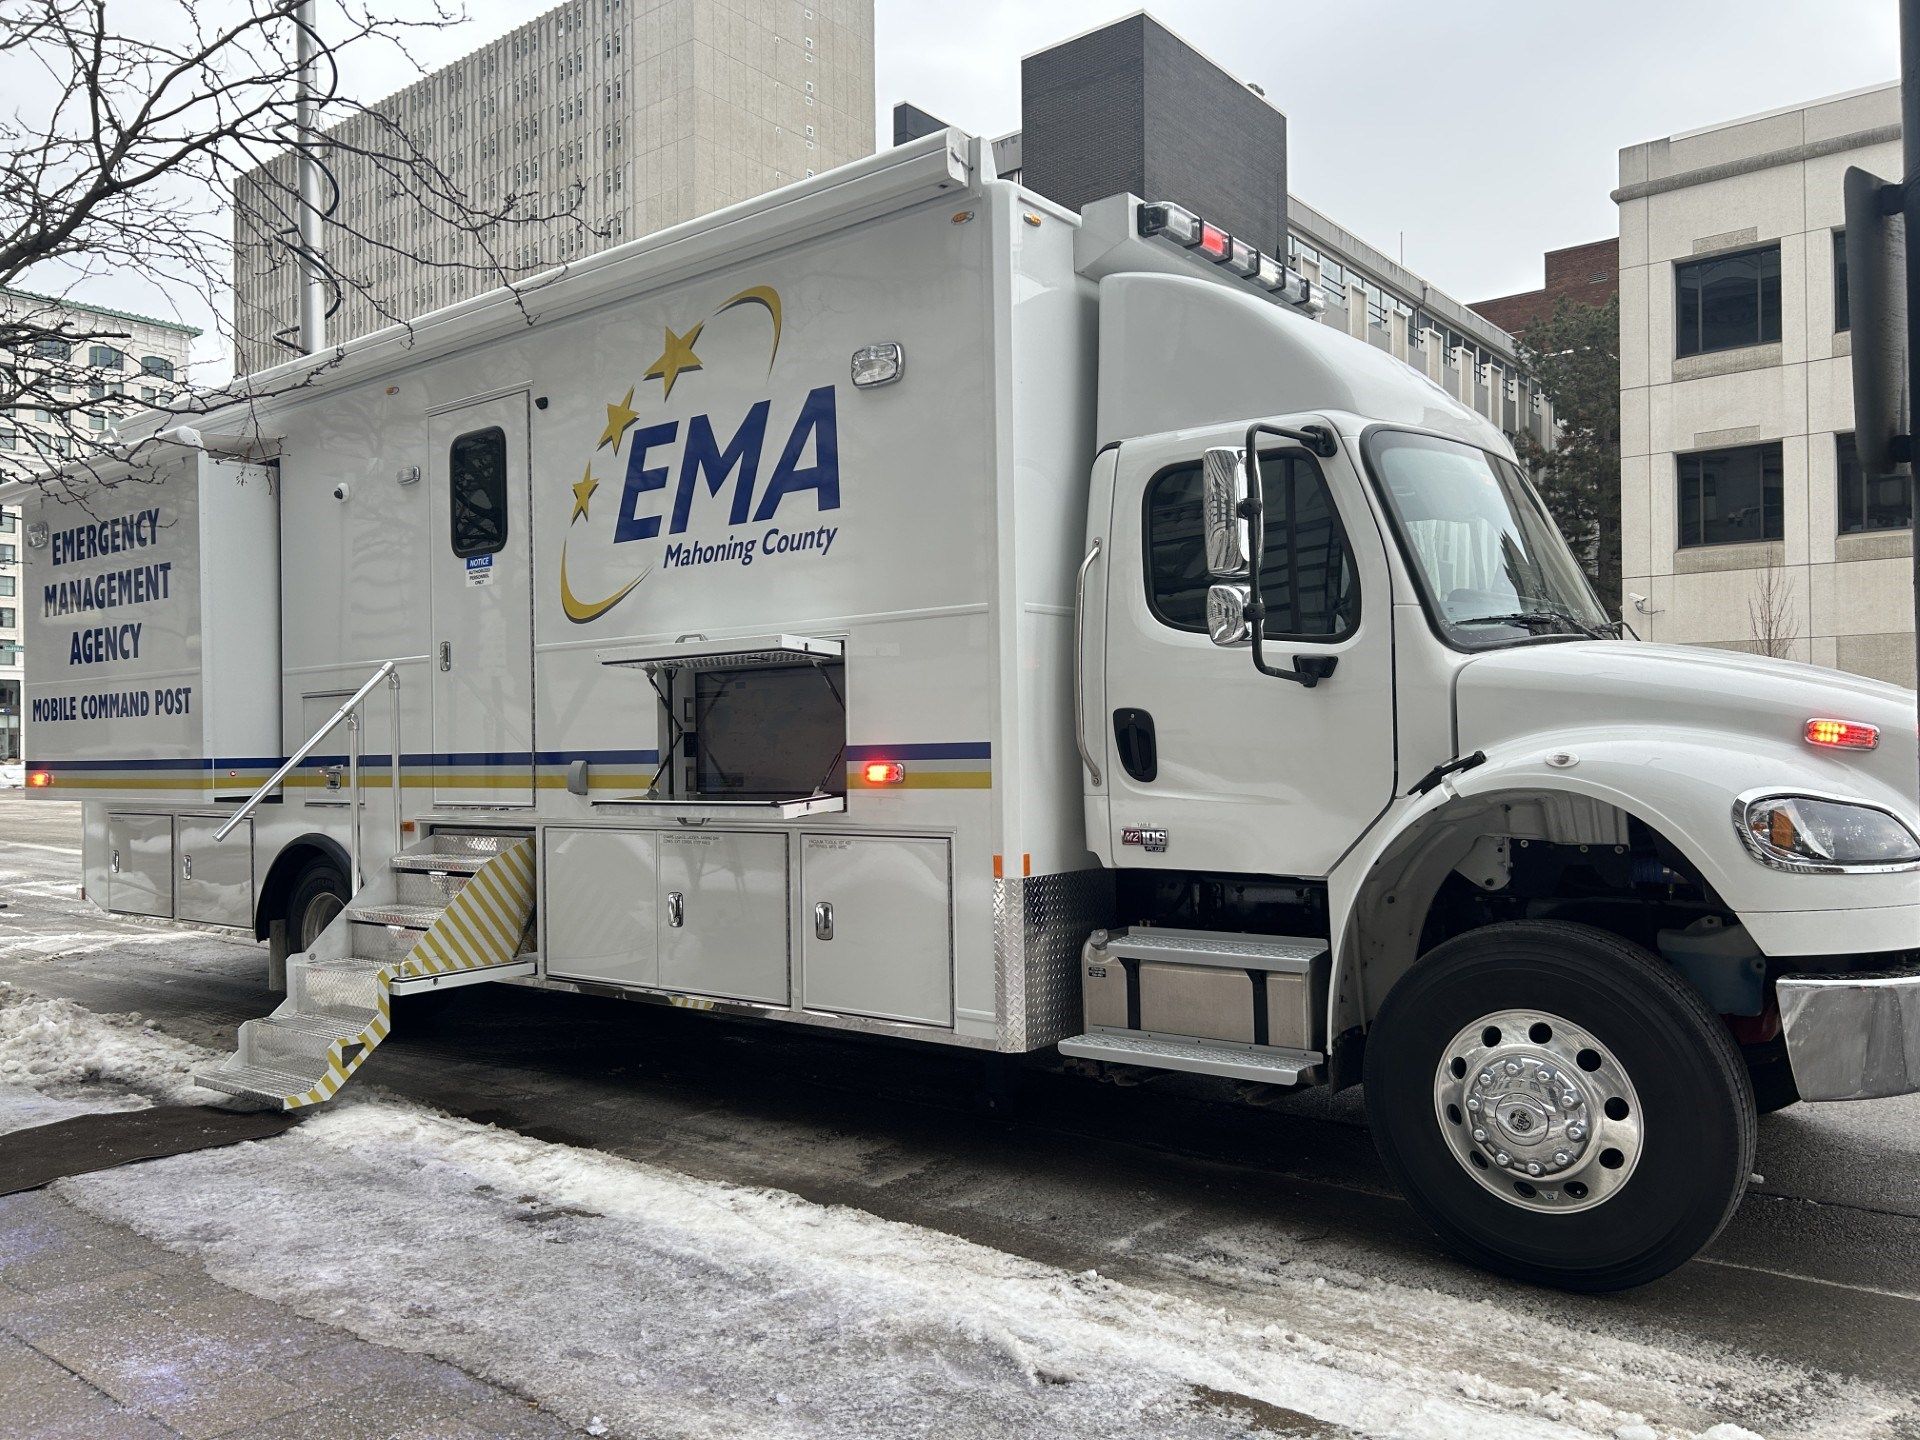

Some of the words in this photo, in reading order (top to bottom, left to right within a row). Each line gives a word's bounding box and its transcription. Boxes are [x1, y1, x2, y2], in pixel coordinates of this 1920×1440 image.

[613, 385, 841, 544] EMA
[52, 508, 160, 566] EMERGENCY
[663, 535, 756, 568] Mahoning
[762, 525, 838, 556] County
[470, 557, 489, 566] NOTICE
[44, 562, 171, 618] MANAGEMENT
[69, 623, 142, 665] AGENCY
[32, 696, 77, 722] MOBILE
[81, 691, 149, 719] COMMAND
[155, 687, 192, 716] POST
[1125, 832, 1139, 842] M2
